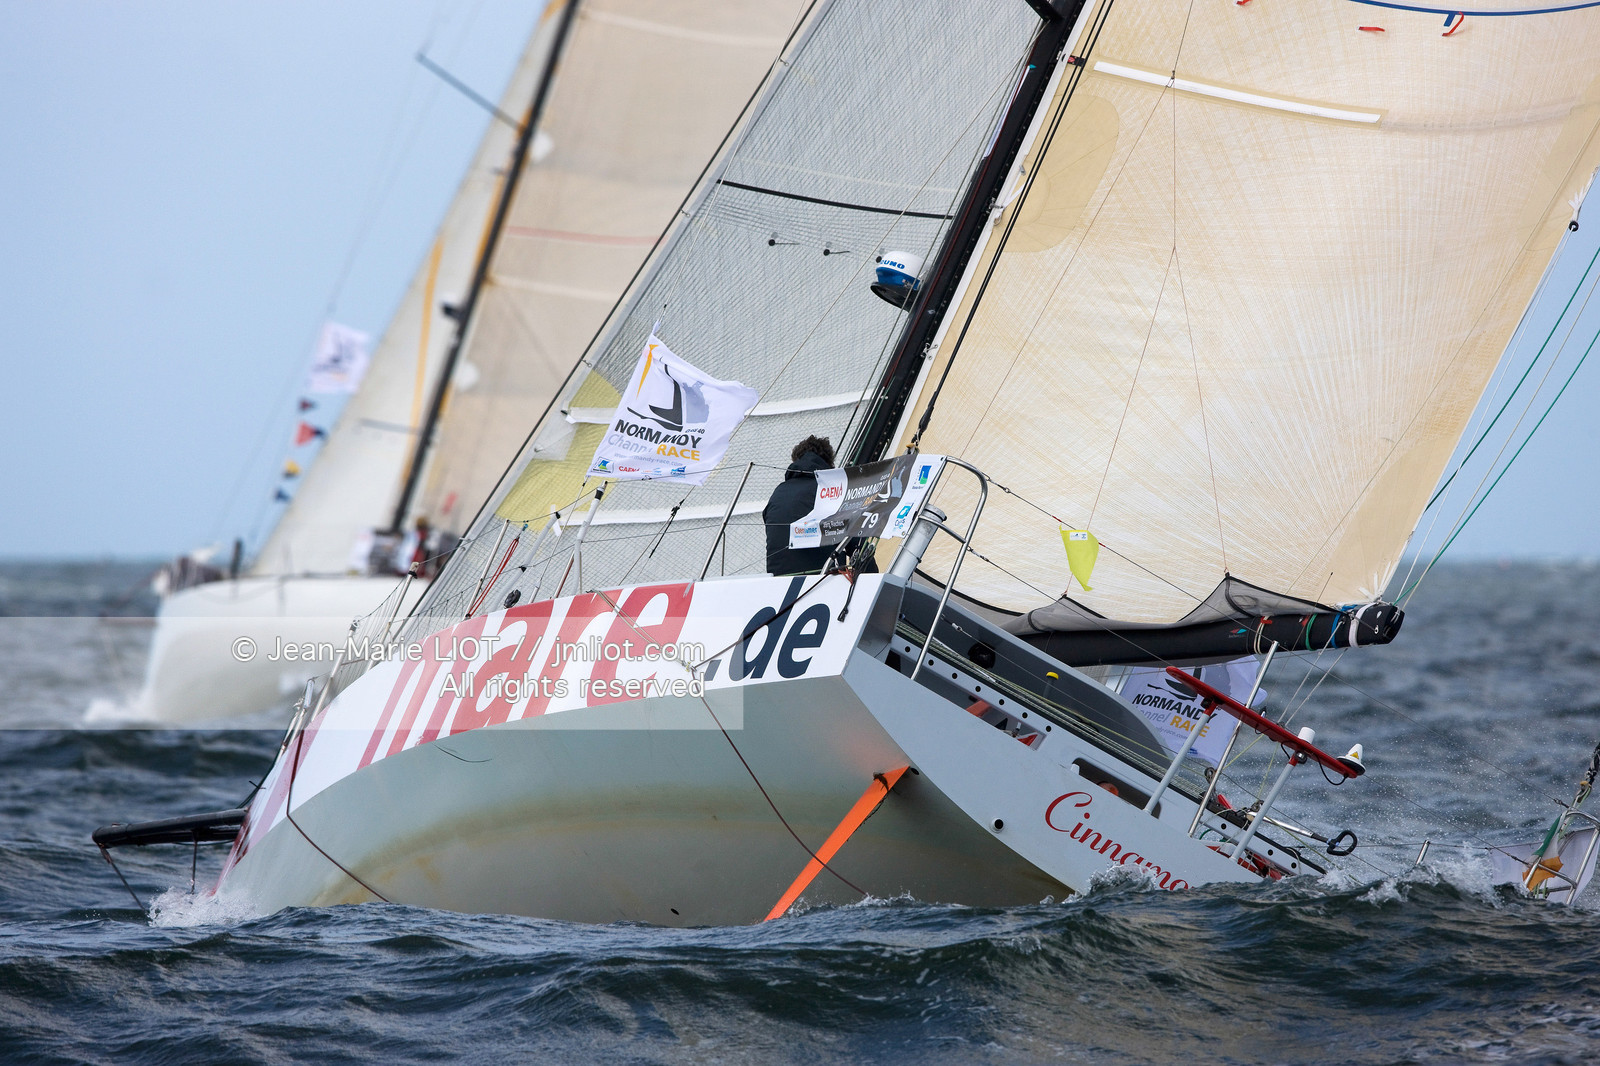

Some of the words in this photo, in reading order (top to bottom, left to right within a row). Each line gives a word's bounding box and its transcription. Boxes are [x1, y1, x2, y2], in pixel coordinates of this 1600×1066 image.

[614, 419, 702, 449] NORMANDY
[656, 444, 701, 461] RACE
[860, 511, 879, 529] 79
